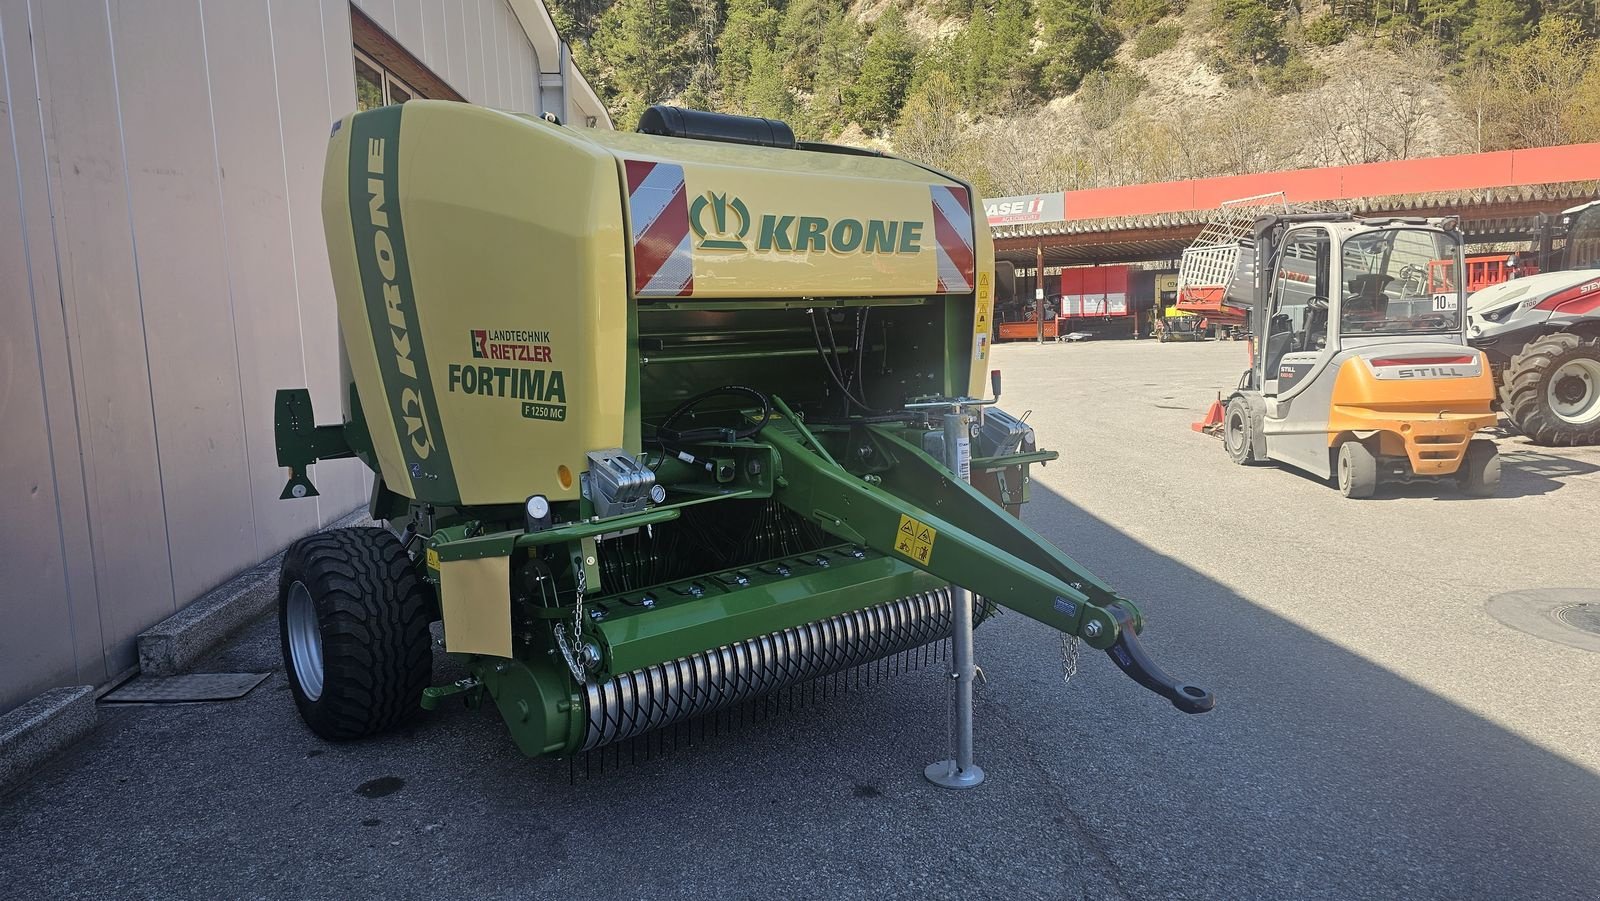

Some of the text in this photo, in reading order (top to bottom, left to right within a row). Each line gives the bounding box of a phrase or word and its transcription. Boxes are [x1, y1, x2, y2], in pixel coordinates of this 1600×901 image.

[985, 201, 1024, 217] ASE
[757, 214, 924, 254] KRONE
[367, 138, 418, 379] KRONE
[1434, 295, 1447, 310] 10
[488, 330, 551, 343] LANDTECHNIK
[489, 344, 553, 363] RIETZLER
[1398, 367, 1464, 379] STILL
[448, 364, 567, 404] FORTIMA
[525, 405, 563, 419] F 1250 MC
